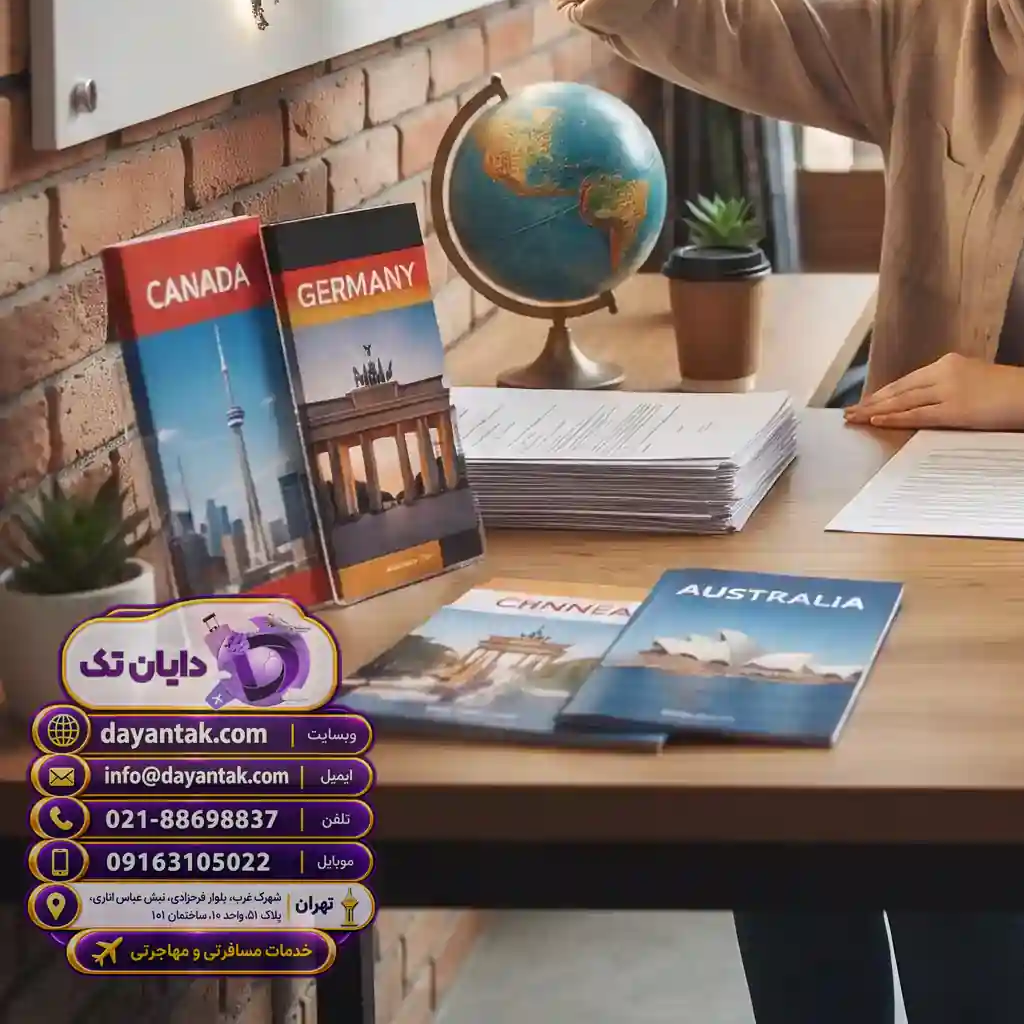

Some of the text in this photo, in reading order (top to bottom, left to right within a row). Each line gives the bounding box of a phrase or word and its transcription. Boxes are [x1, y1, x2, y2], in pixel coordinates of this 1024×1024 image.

[145, 262, 251, 310] CANADA
[297, 261, 415, 309] GERMANY
[675, 583, 865, 611] AUSTRALIA
